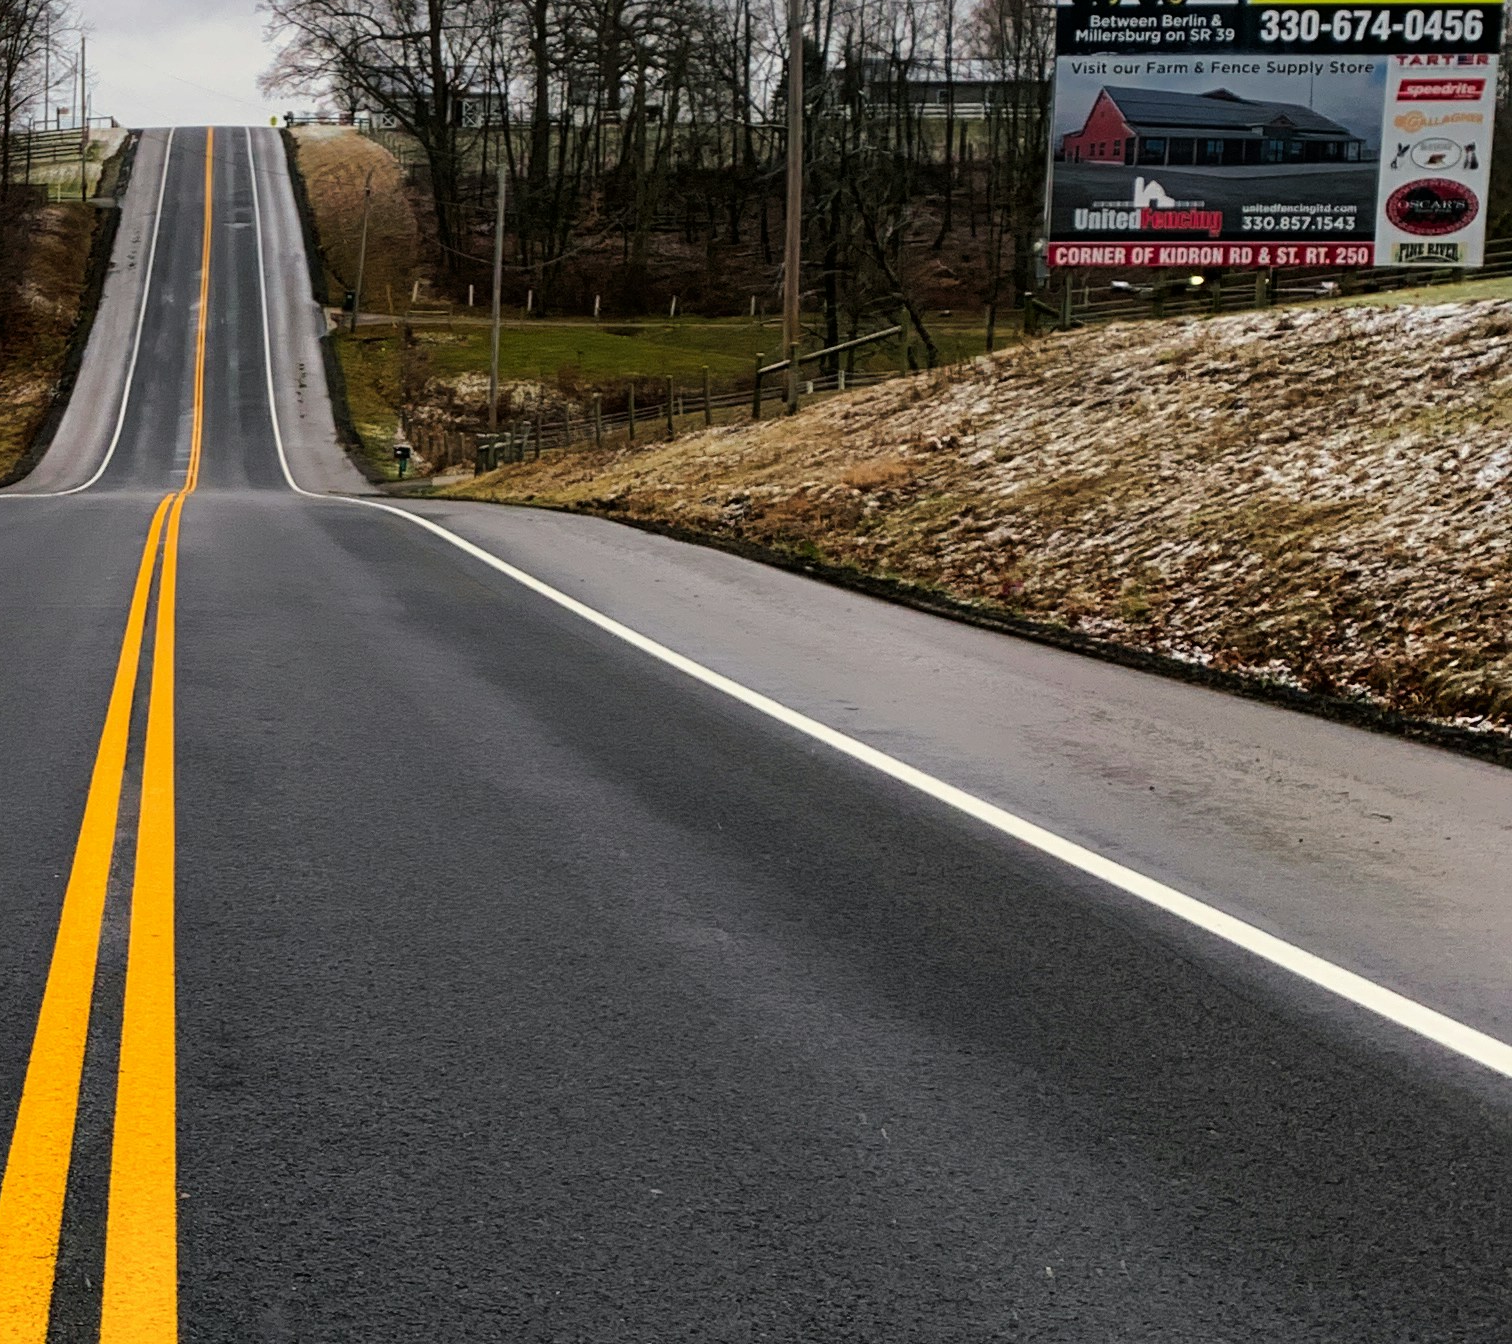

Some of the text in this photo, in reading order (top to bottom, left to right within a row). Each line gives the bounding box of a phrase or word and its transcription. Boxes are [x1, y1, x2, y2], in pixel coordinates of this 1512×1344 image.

[1090, 14, 1222, 28] Between Berlin &
[1260, 9, 1484, 42] 330-674-0456
[1075, 28, 1235, 44] Millersburg on SR 39
[1071, 60, 1375, 76] Visit our Farm & Fence Supply Store
[1407, 83, 1477, 97] speedrite
[1242, 216, 1355, 230] 330.857.1543
[1055, 247, 1369, 265] CORNER OF KIDRON RD & ST. RT. 250
